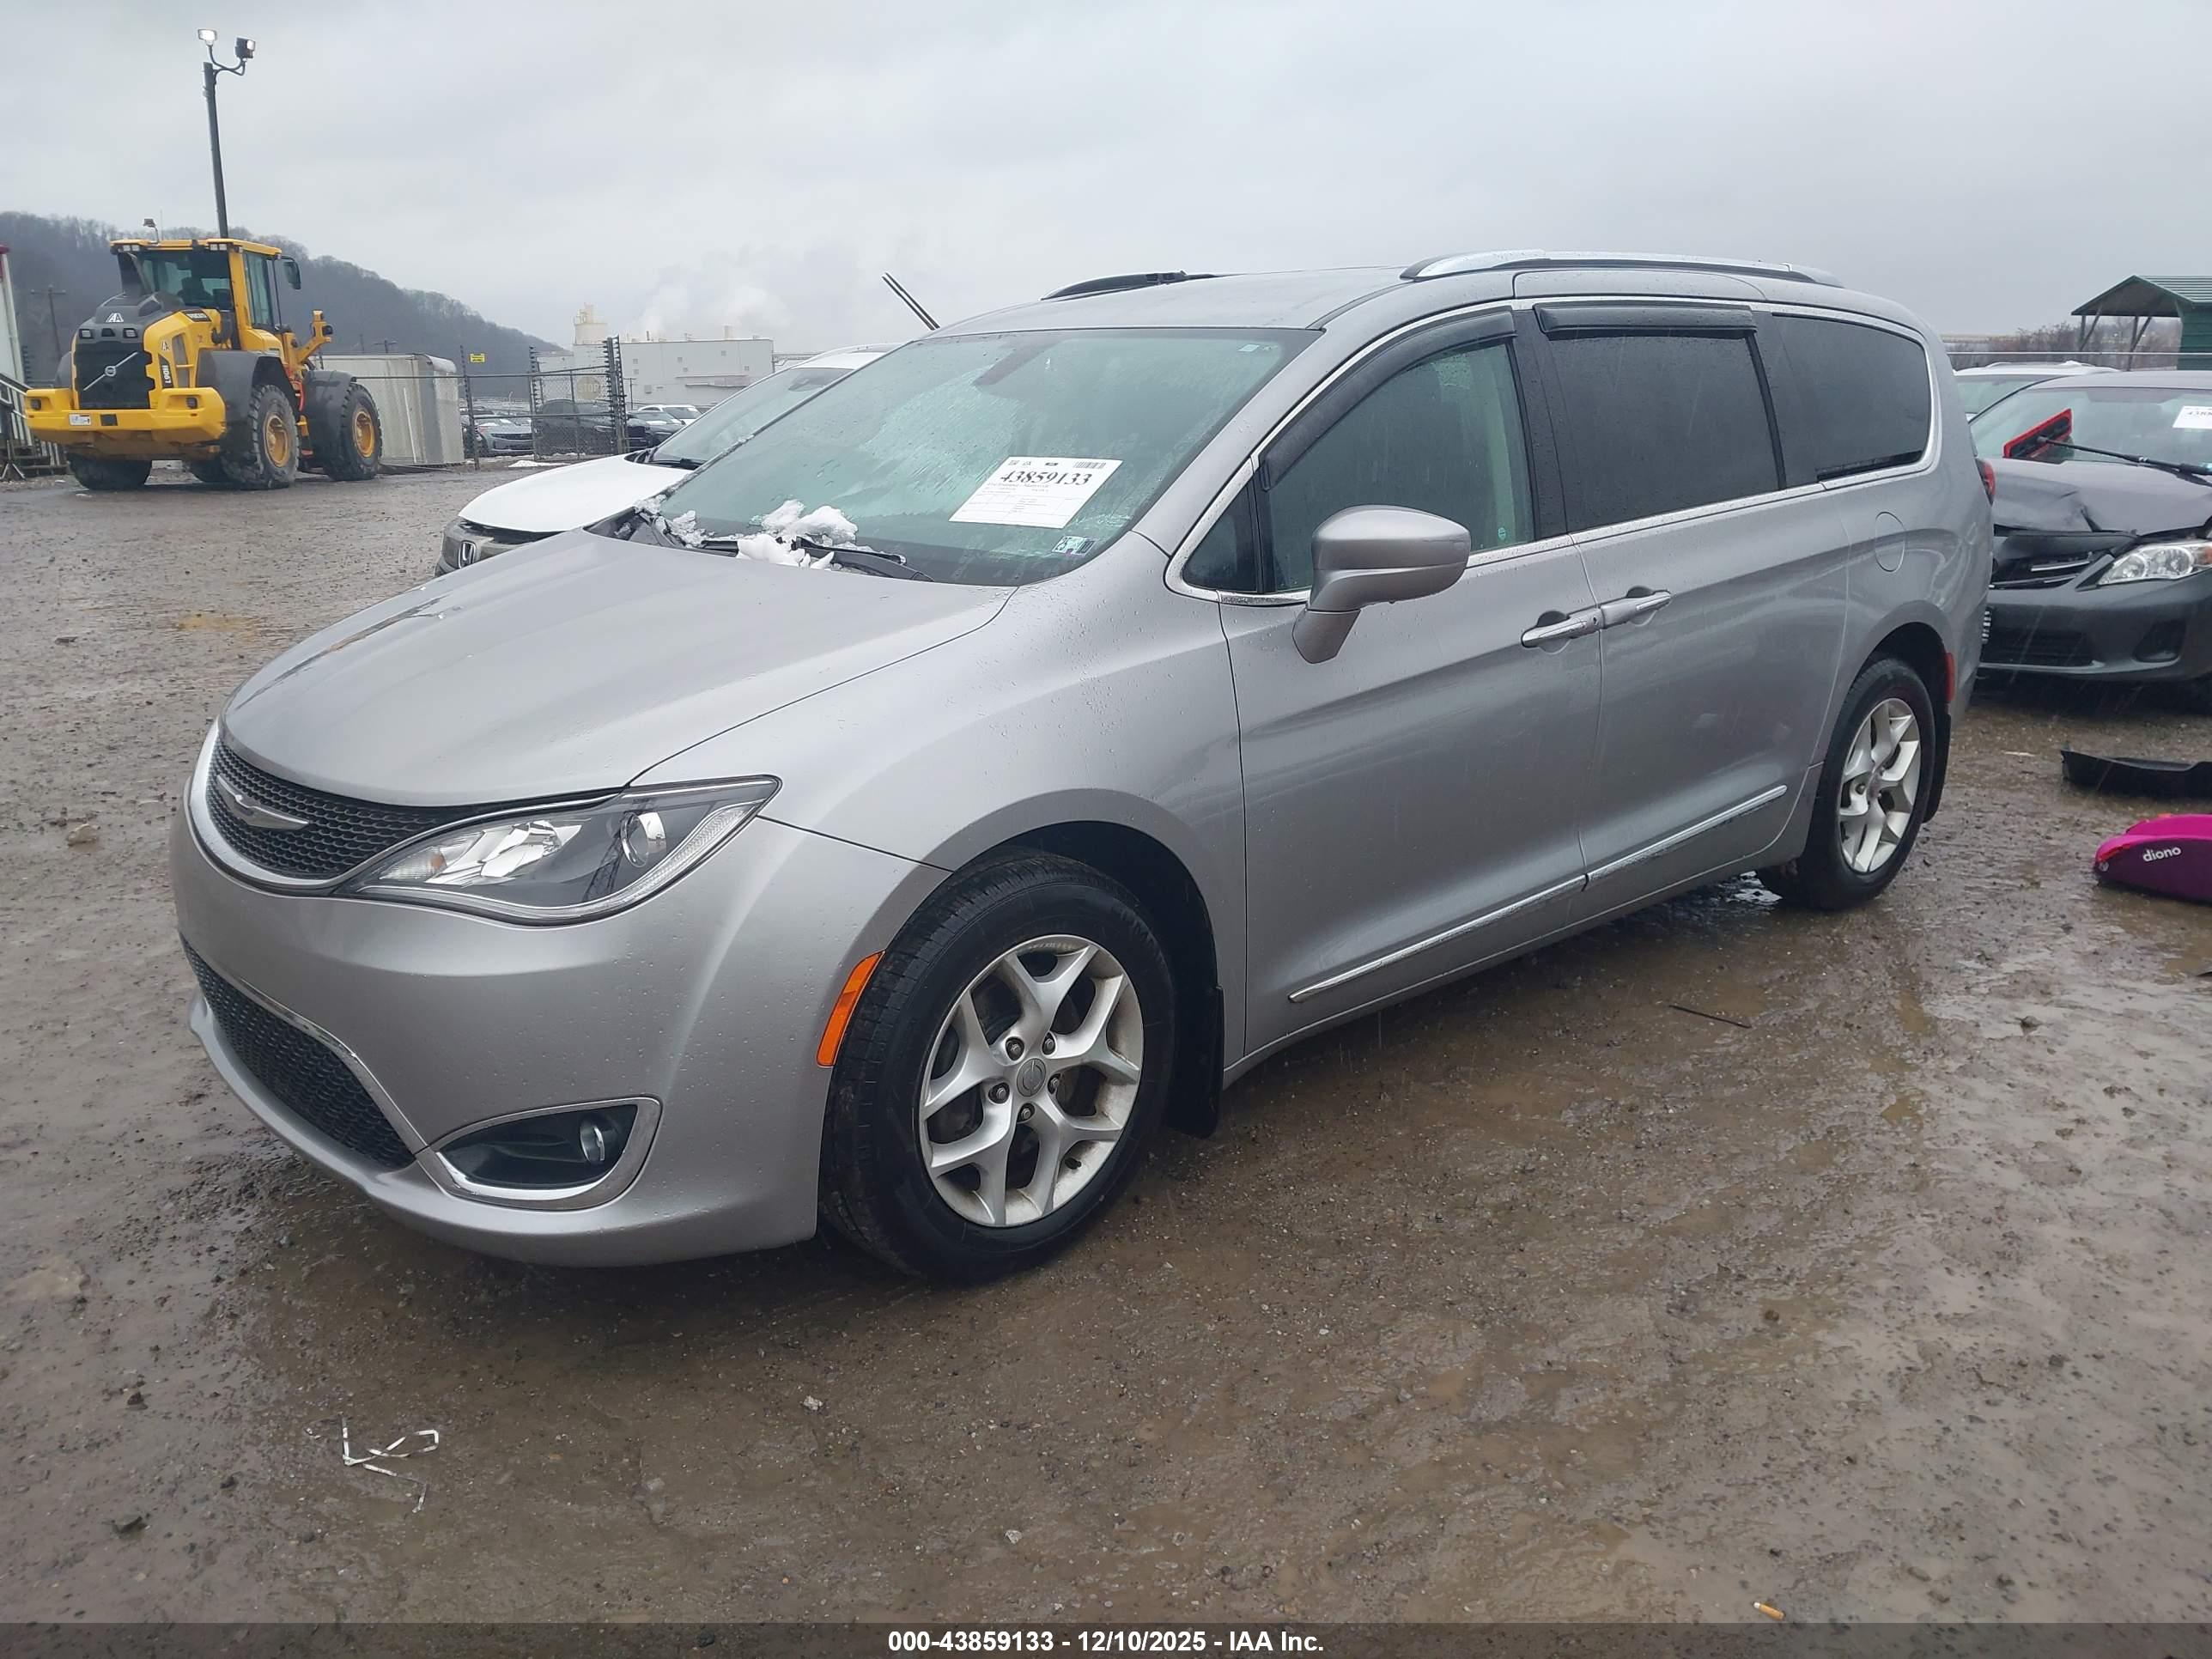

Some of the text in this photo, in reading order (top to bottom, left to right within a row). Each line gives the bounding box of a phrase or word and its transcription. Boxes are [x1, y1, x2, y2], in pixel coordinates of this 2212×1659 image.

[577, 383, 599, 393] STOP
[1000, 470, 1093, 486] 43859133
[2142, 846, 2182, 862] diono
